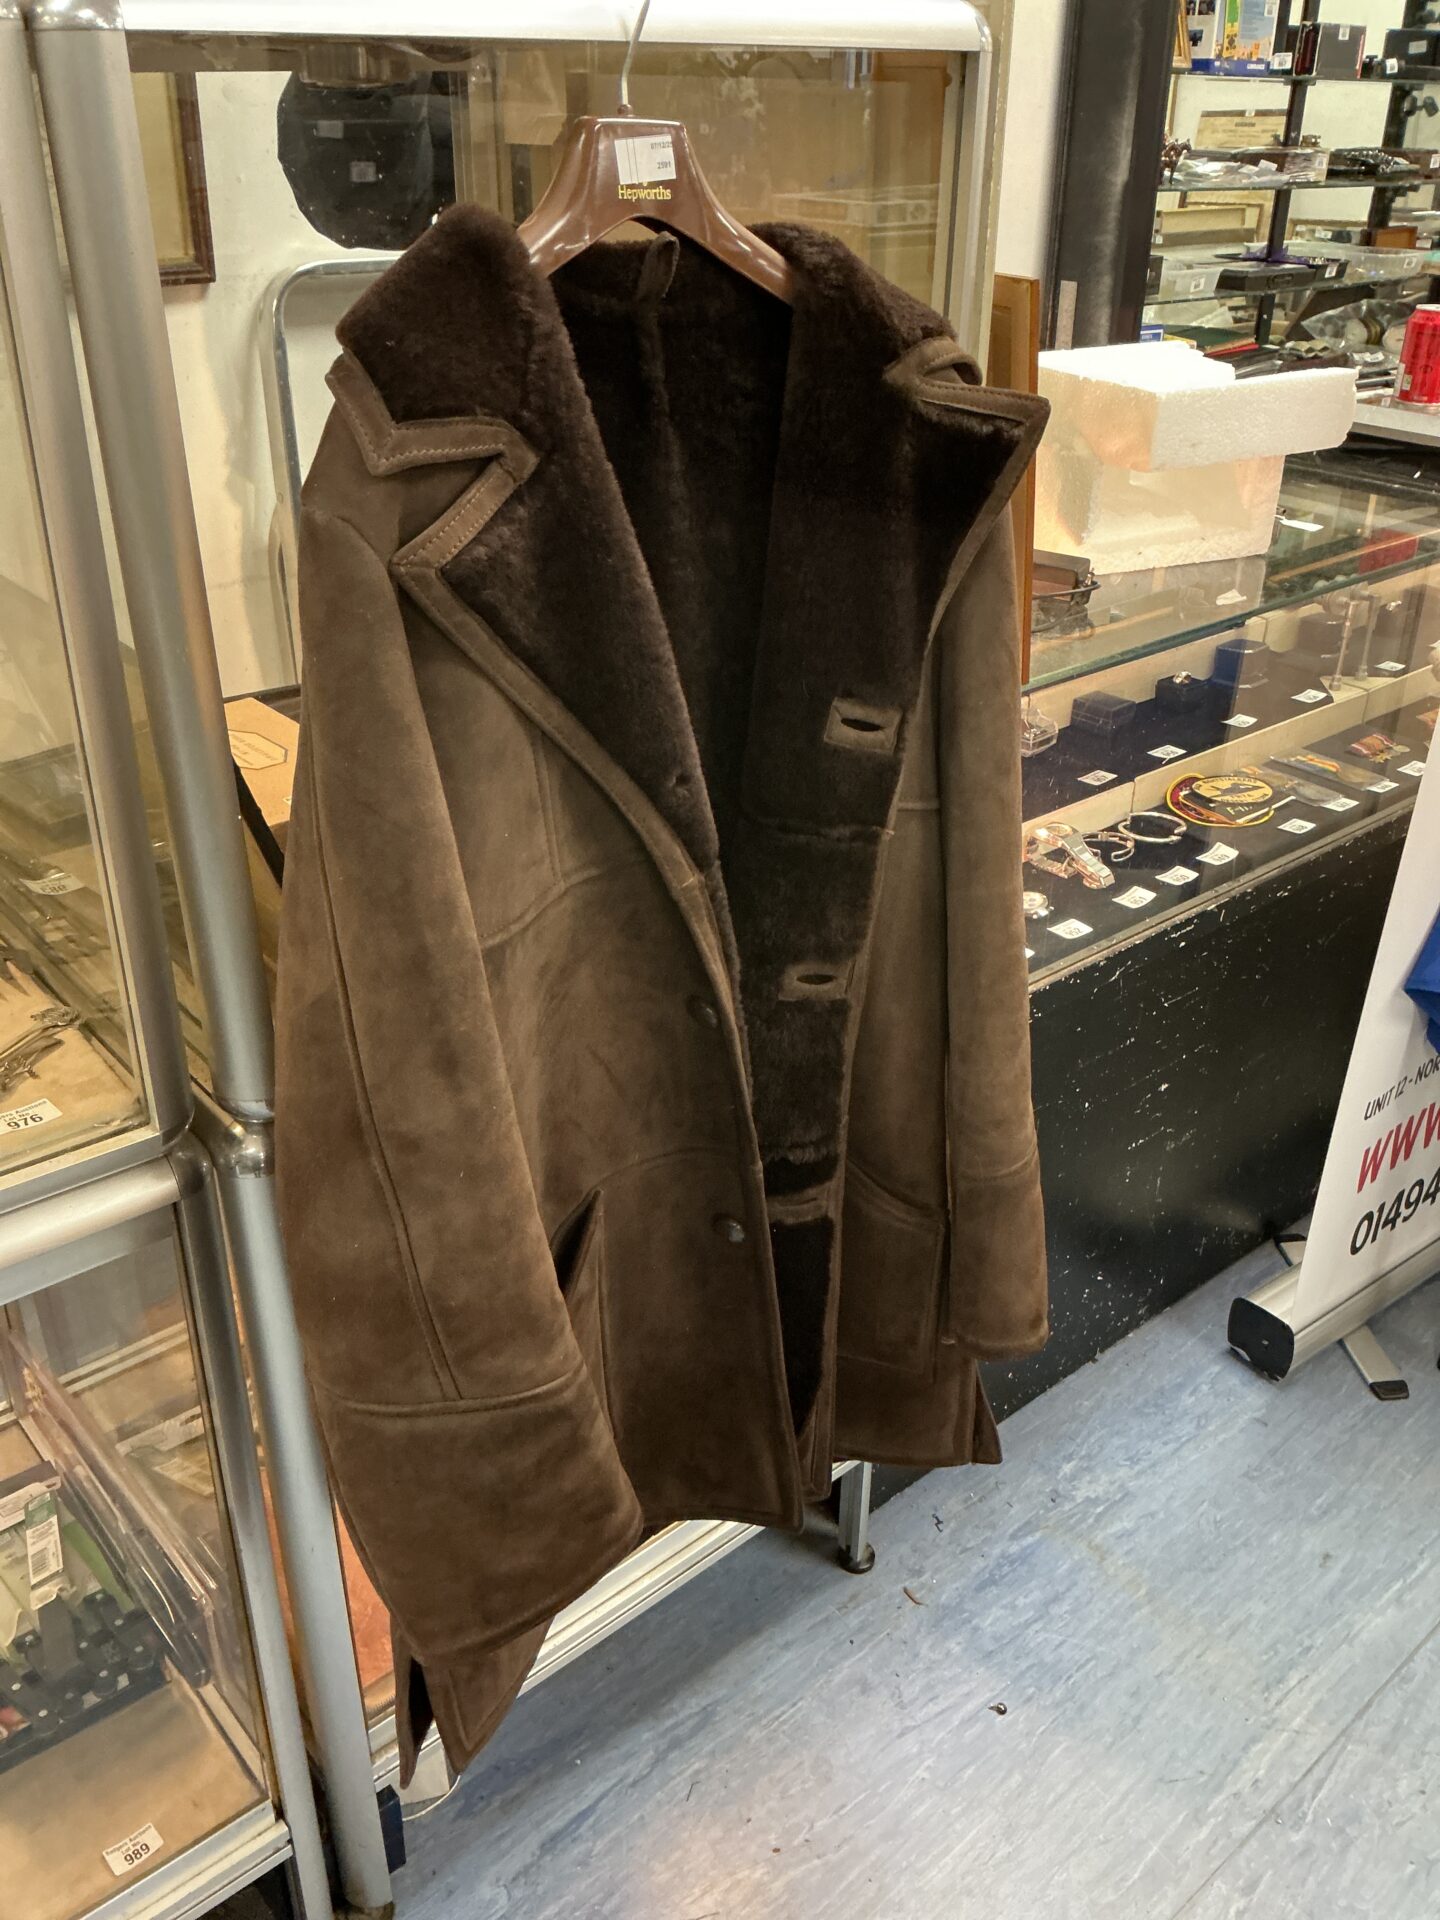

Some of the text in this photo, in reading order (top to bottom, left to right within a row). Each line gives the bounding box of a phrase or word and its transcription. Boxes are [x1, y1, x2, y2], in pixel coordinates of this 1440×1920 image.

[618, 185, 671, 202] Hepworths
[1364, 1085, 1395, 1120] UNIT
[1395, 1076, 1407, 1099] 12
[1414, 1055, 1440, 1085] NOR
[7, 1114, 43, 1129] 976
[1350, 1166, 1440, 1256] 01494
[124, 1843, 150, 1865] 989
